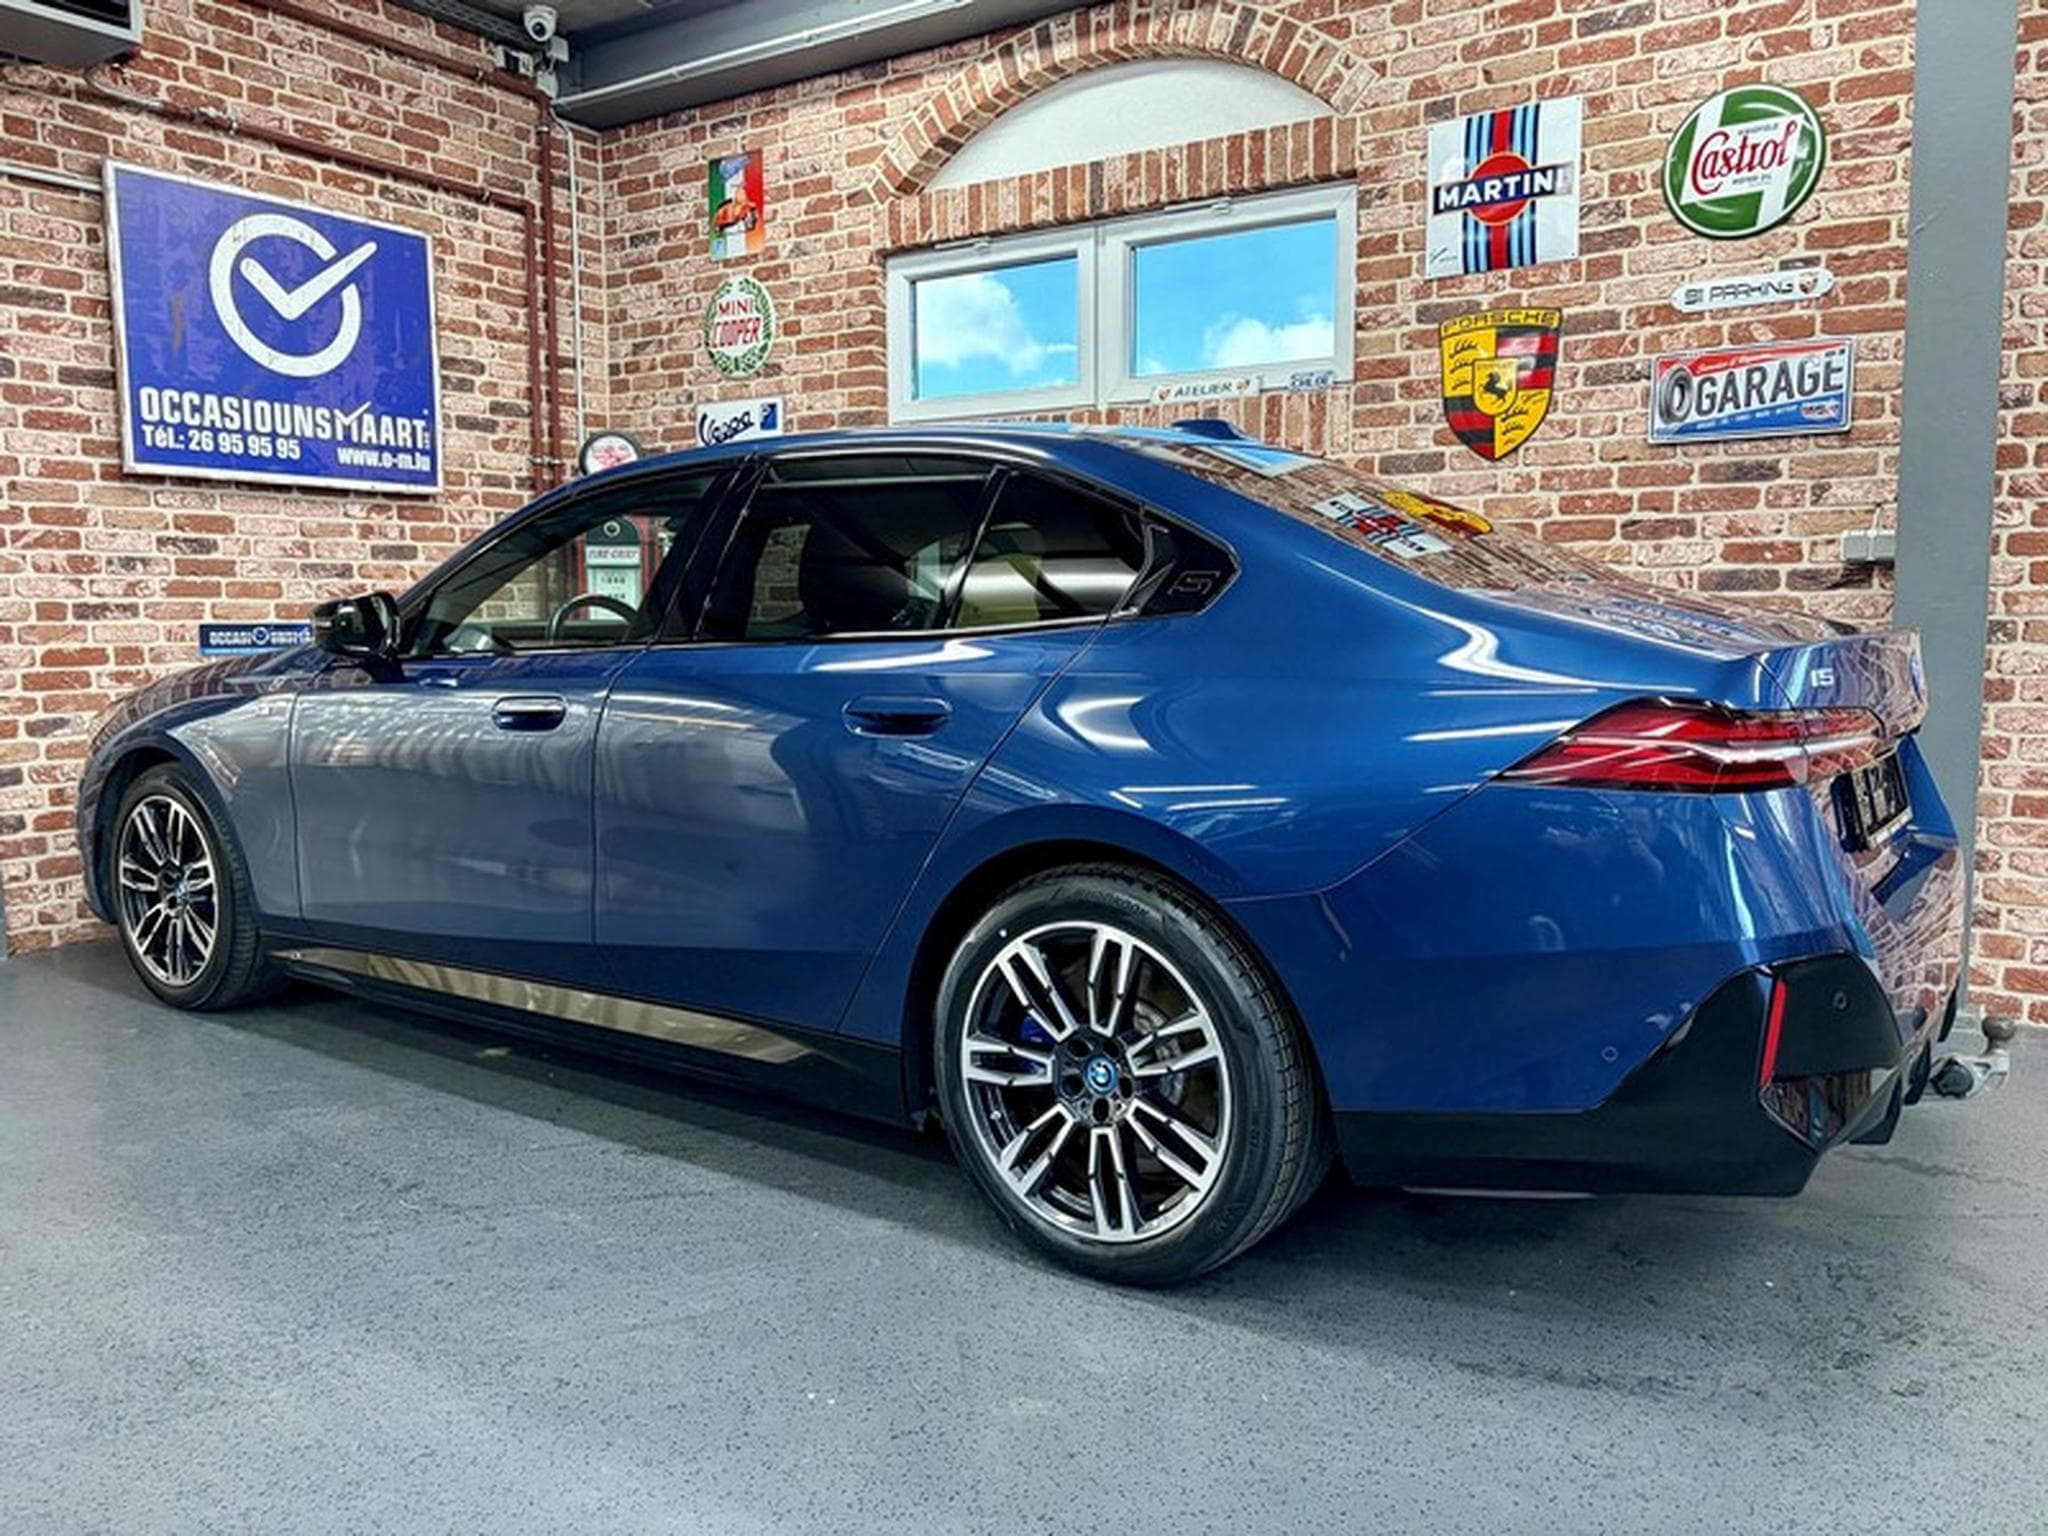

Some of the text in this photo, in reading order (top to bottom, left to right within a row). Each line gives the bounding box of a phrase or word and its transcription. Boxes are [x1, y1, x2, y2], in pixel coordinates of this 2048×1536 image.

[1691, 120, 1798, 195] Castrol
[1438, 168, 1565, 210] MARTINI
[718, 298, 754, 316] MINI
[1442, 308, 1556, 334] PORSCHE
[711, 317, 761, 348] COOPER
[1694, 348, 1846, 417] GARAGE
[188, 429, 215, 452] 26
[218, 432, 244, 455] 95
[247, 434, 273, 457] 95
[276, 437, 301, 460] 95
